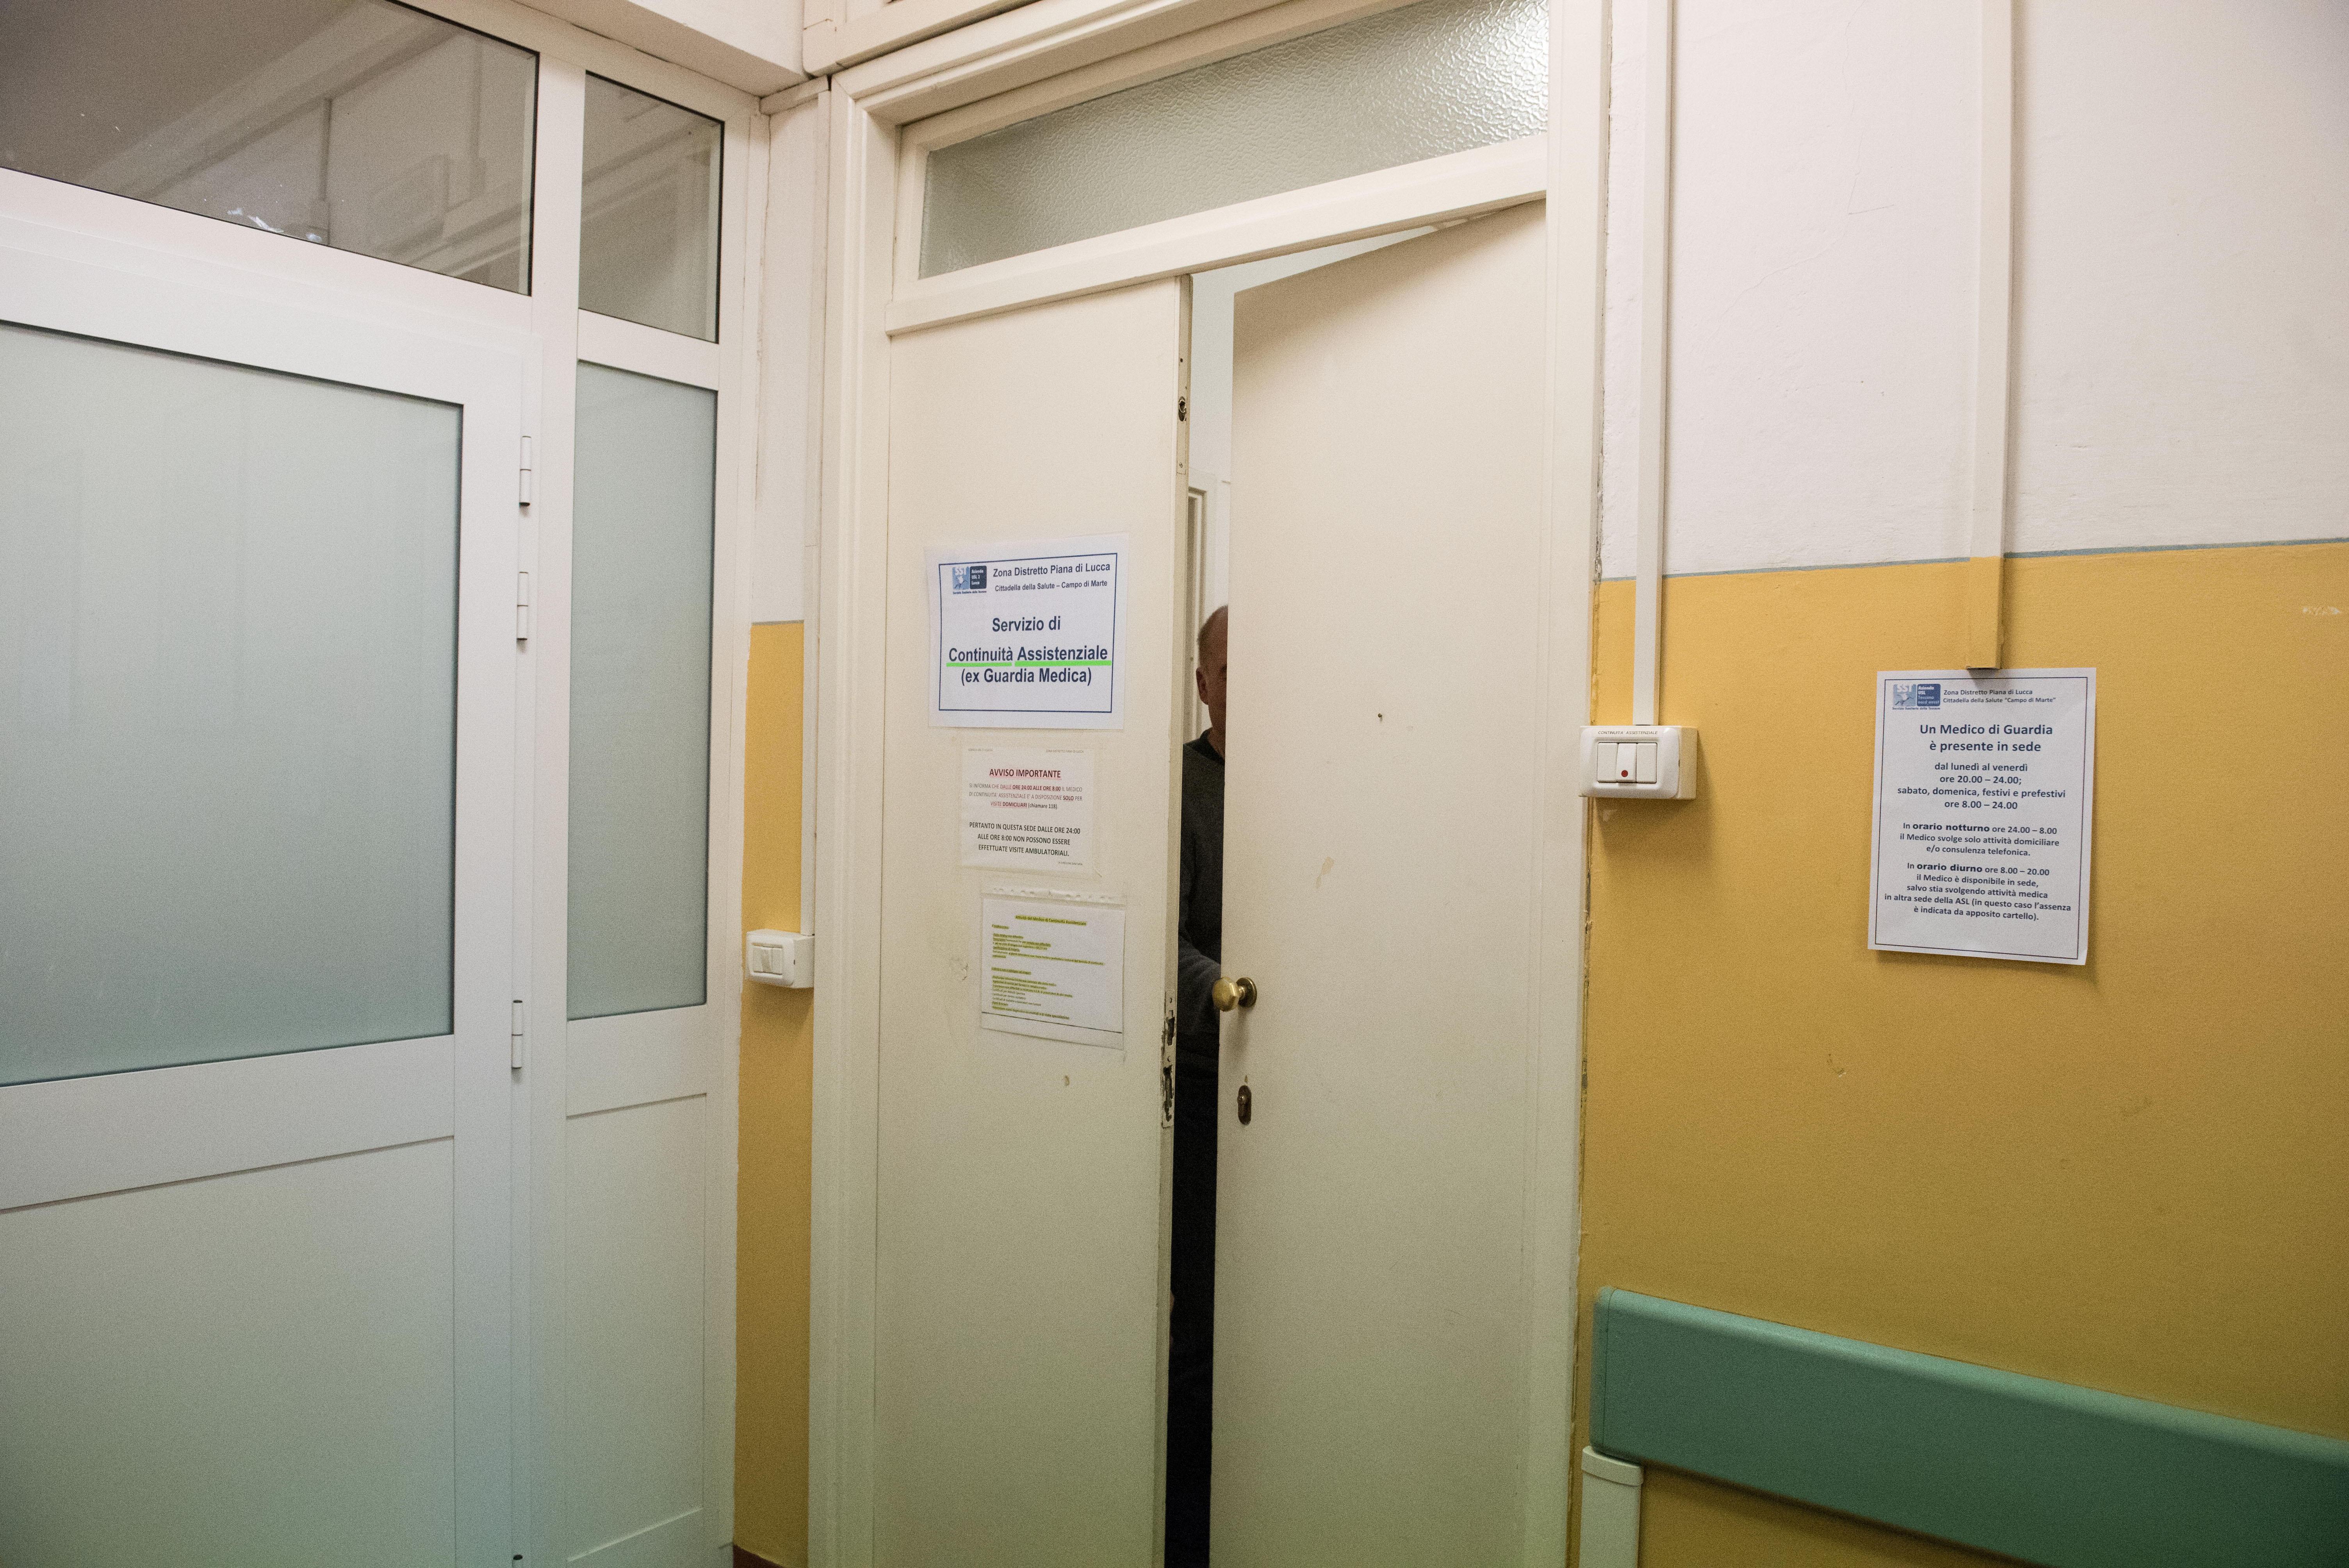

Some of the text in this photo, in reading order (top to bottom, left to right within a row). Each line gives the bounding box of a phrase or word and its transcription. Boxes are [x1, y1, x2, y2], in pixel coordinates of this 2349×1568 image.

[993, 563, 1110, 577] Zona Distretto Piana di Lucca
[992, 615, 1060, 632] Servizio di
[949, 645, 1108, 662] Continuità Assistenziale
[961, 667, 1091, 686] (ex Guardia Medica)
[1920, 724, 2053, 735] Un Medico di Guardia
[1930, 740, 2041, 753] è presente in sede
[989, 768, 1061, 778] AVVISO IMPORTANTE
[1951, 763, 1979, 771] lunedì
[1993, 763, 2028, 772] venerdì
[1957, 775, 1983, 783] 20.00
[1993, 776, 2021, 785] 24.00;
[1898, 786, 1930, 796] sabato,
[1932, 787, 1980, 797] domenica,
[1982, 788, 2010, 796] festivi
[2021, 789, 2066, 798] prefestivi
[1992, 801, 2018, 809] 24.00
[1937, 835, 1962, 844] svolge
[2014, 837, 2060, 846] domiciliare
[1025, 848, 1069, 856] AMBULATORIALI.
[1926, 845, 1940, 853] e/o
[1987, 848, 2030, 856] telefonica.
[1950, 864, 1983, 873] diurno
[1923, 874, 1953, 882] Medico
[1961, 876, 2005, 885] disponibile
[2017, 879, 2039, 888] sede,
[1945, 887, 1985, 895] svolgendo
[1972, 898, 1982, 907] (in
[1921, 906, 1952, 914] indicata
[2003, 912, 2039, 921] cartello).
